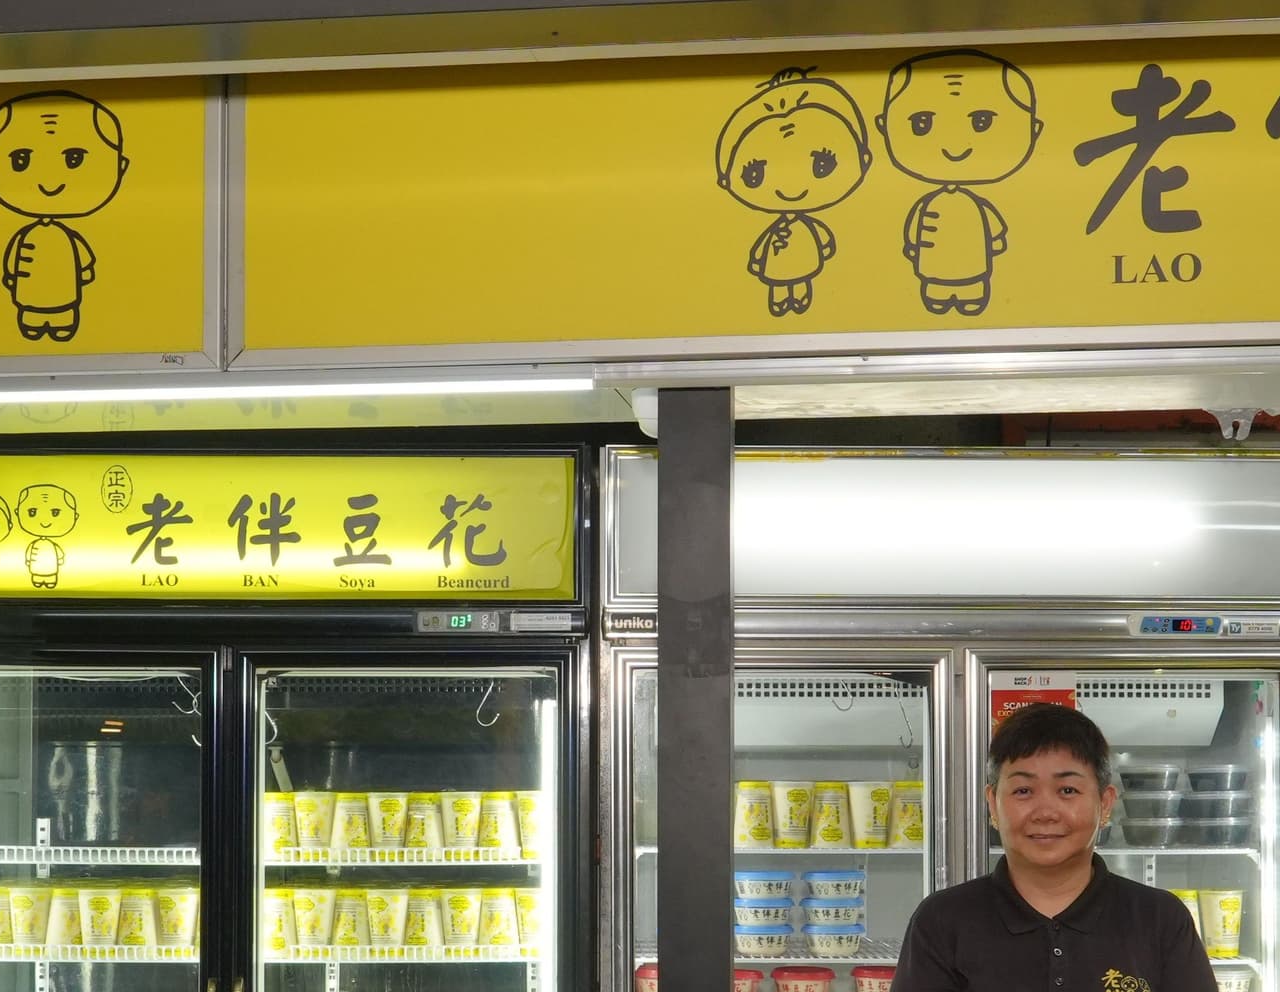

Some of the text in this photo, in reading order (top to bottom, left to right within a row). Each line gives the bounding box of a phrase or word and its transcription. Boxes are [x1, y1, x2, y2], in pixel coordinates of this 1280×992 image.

[1112, 253, 1202, 285] LAO
[107, 470, 126, 509] 正宗
[126, 492, 508, 568] 老伴豆花
[141, 575, 510, 590] LAO BAN Soya Beancurd
